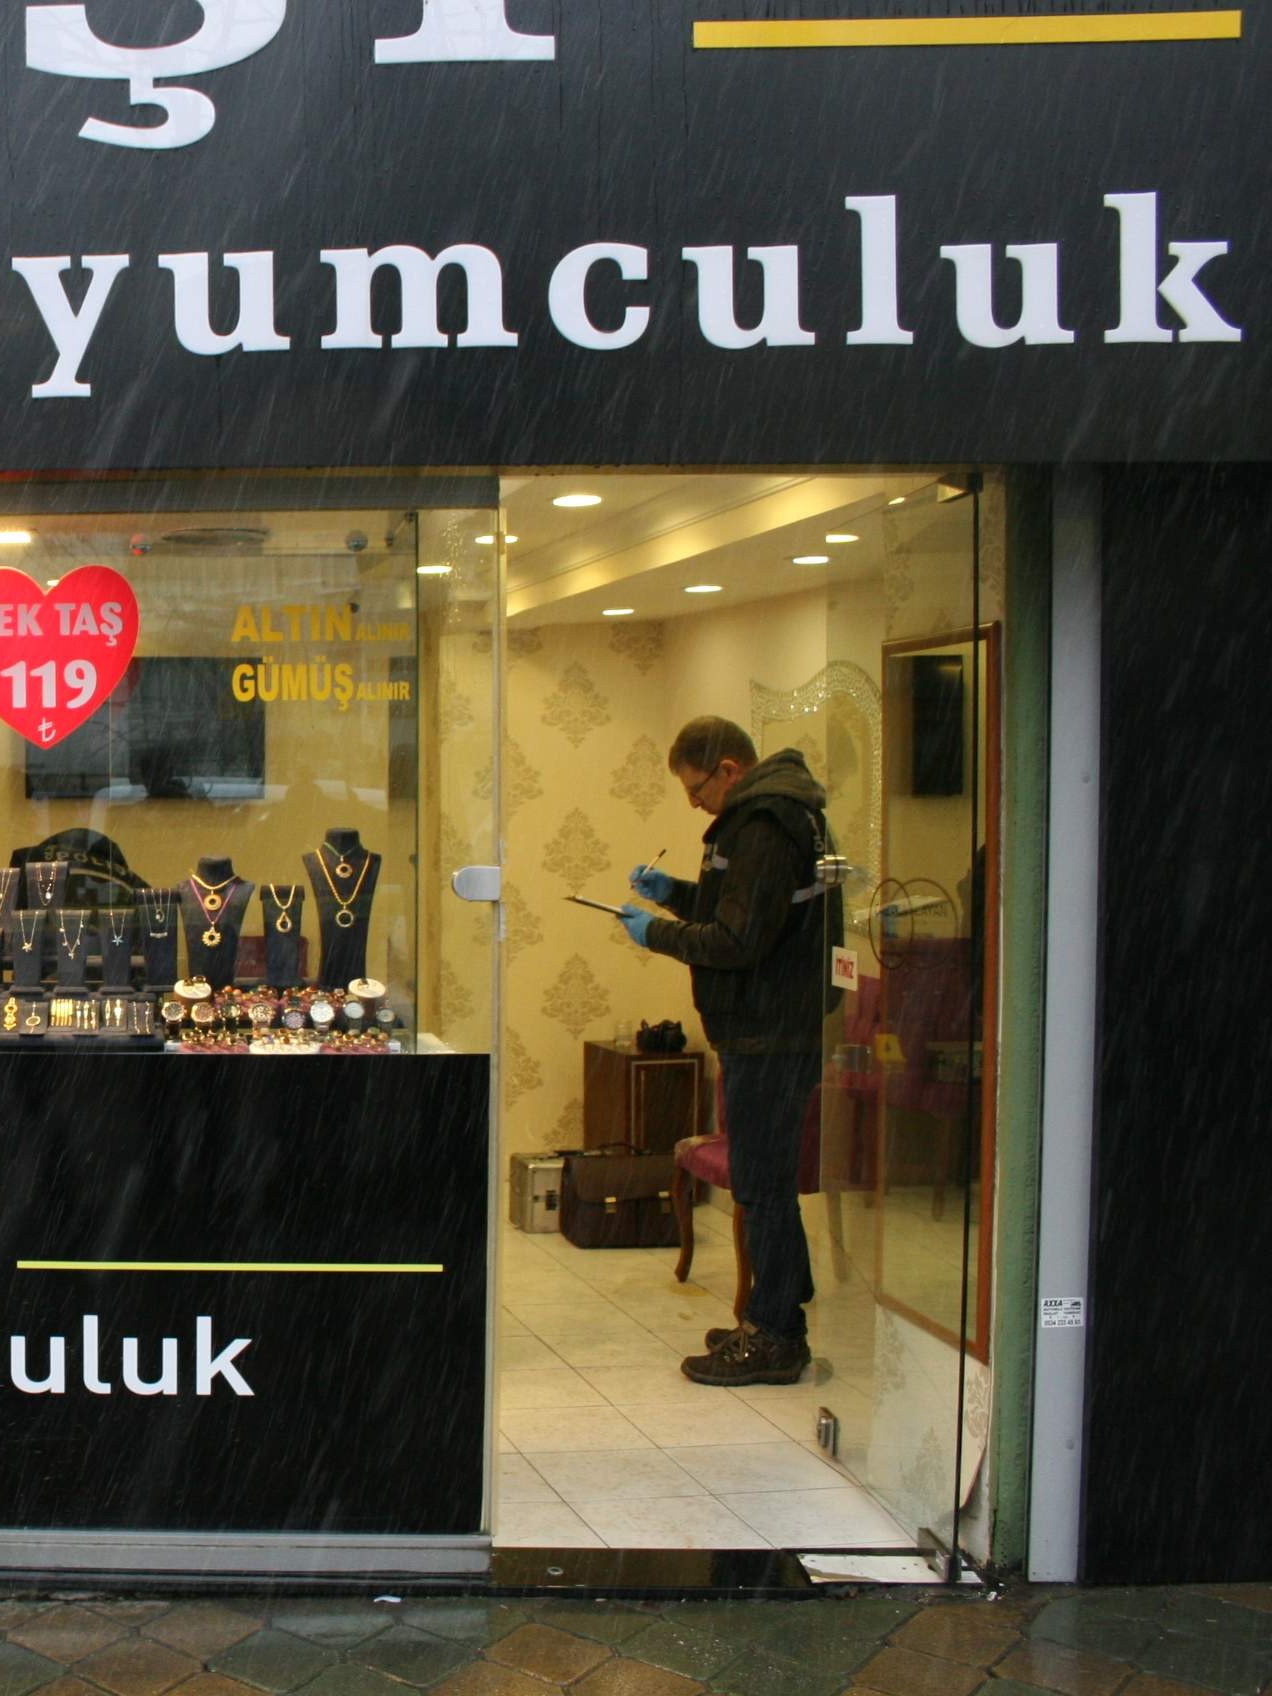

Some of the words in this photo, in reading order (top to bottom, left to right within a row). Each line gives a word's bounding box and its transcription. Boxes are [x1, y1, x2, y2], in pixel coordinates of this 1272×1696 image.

[54, 601, 124, 647] TAŞ
[231, 603, 353, 642] ALTIN
[0, 658, 98, 710] 119
[232, 655, 355, 712] GÜMÜŞ
